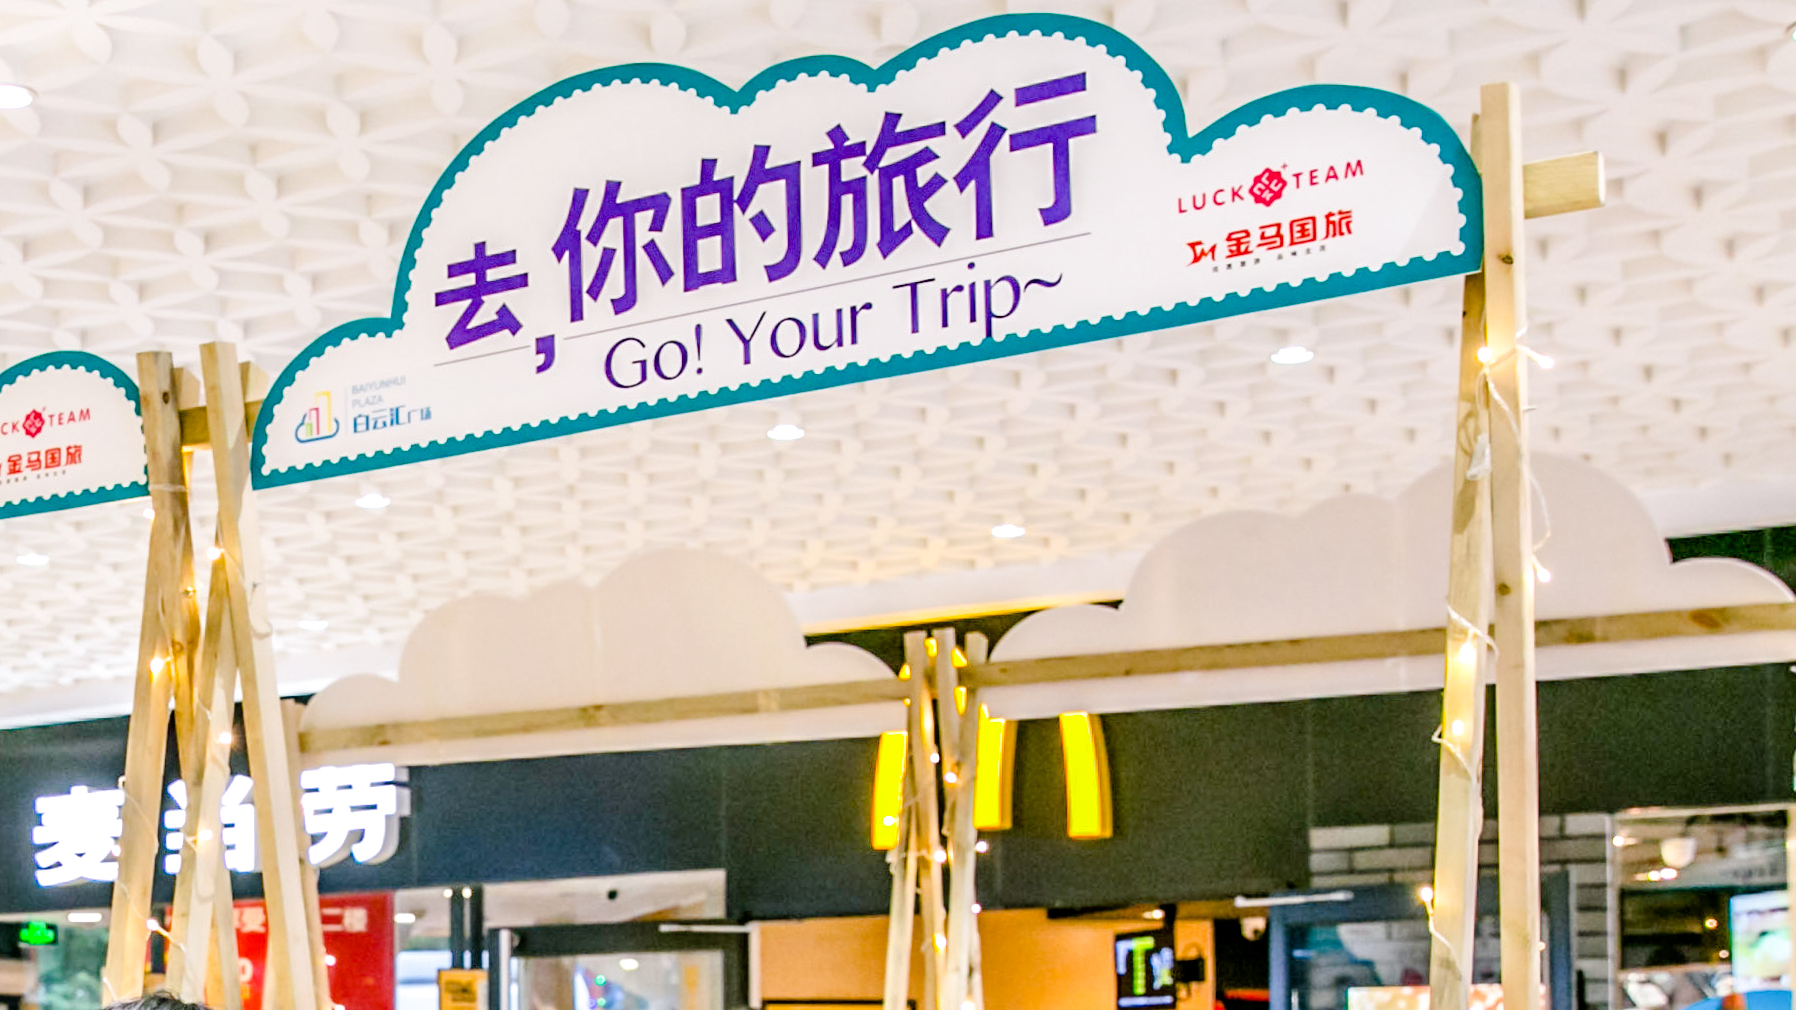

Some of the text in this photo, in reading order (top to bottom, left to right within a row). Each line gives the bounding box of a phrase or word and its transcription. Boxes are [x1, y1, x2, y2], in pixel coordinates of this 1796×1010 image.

[1177, 159, 1364, 214] LUCK TEAM
[1225, 209, 1353, 259] 金马国旅
[603, 322, 704, 389] Go!
[724, 299, 873, 366] Your
[351, 376, 406, 395] BAIYUNHUI
[351, 395, 383, 408] PLAZA
[48, 408, 91, 428] TEAM
